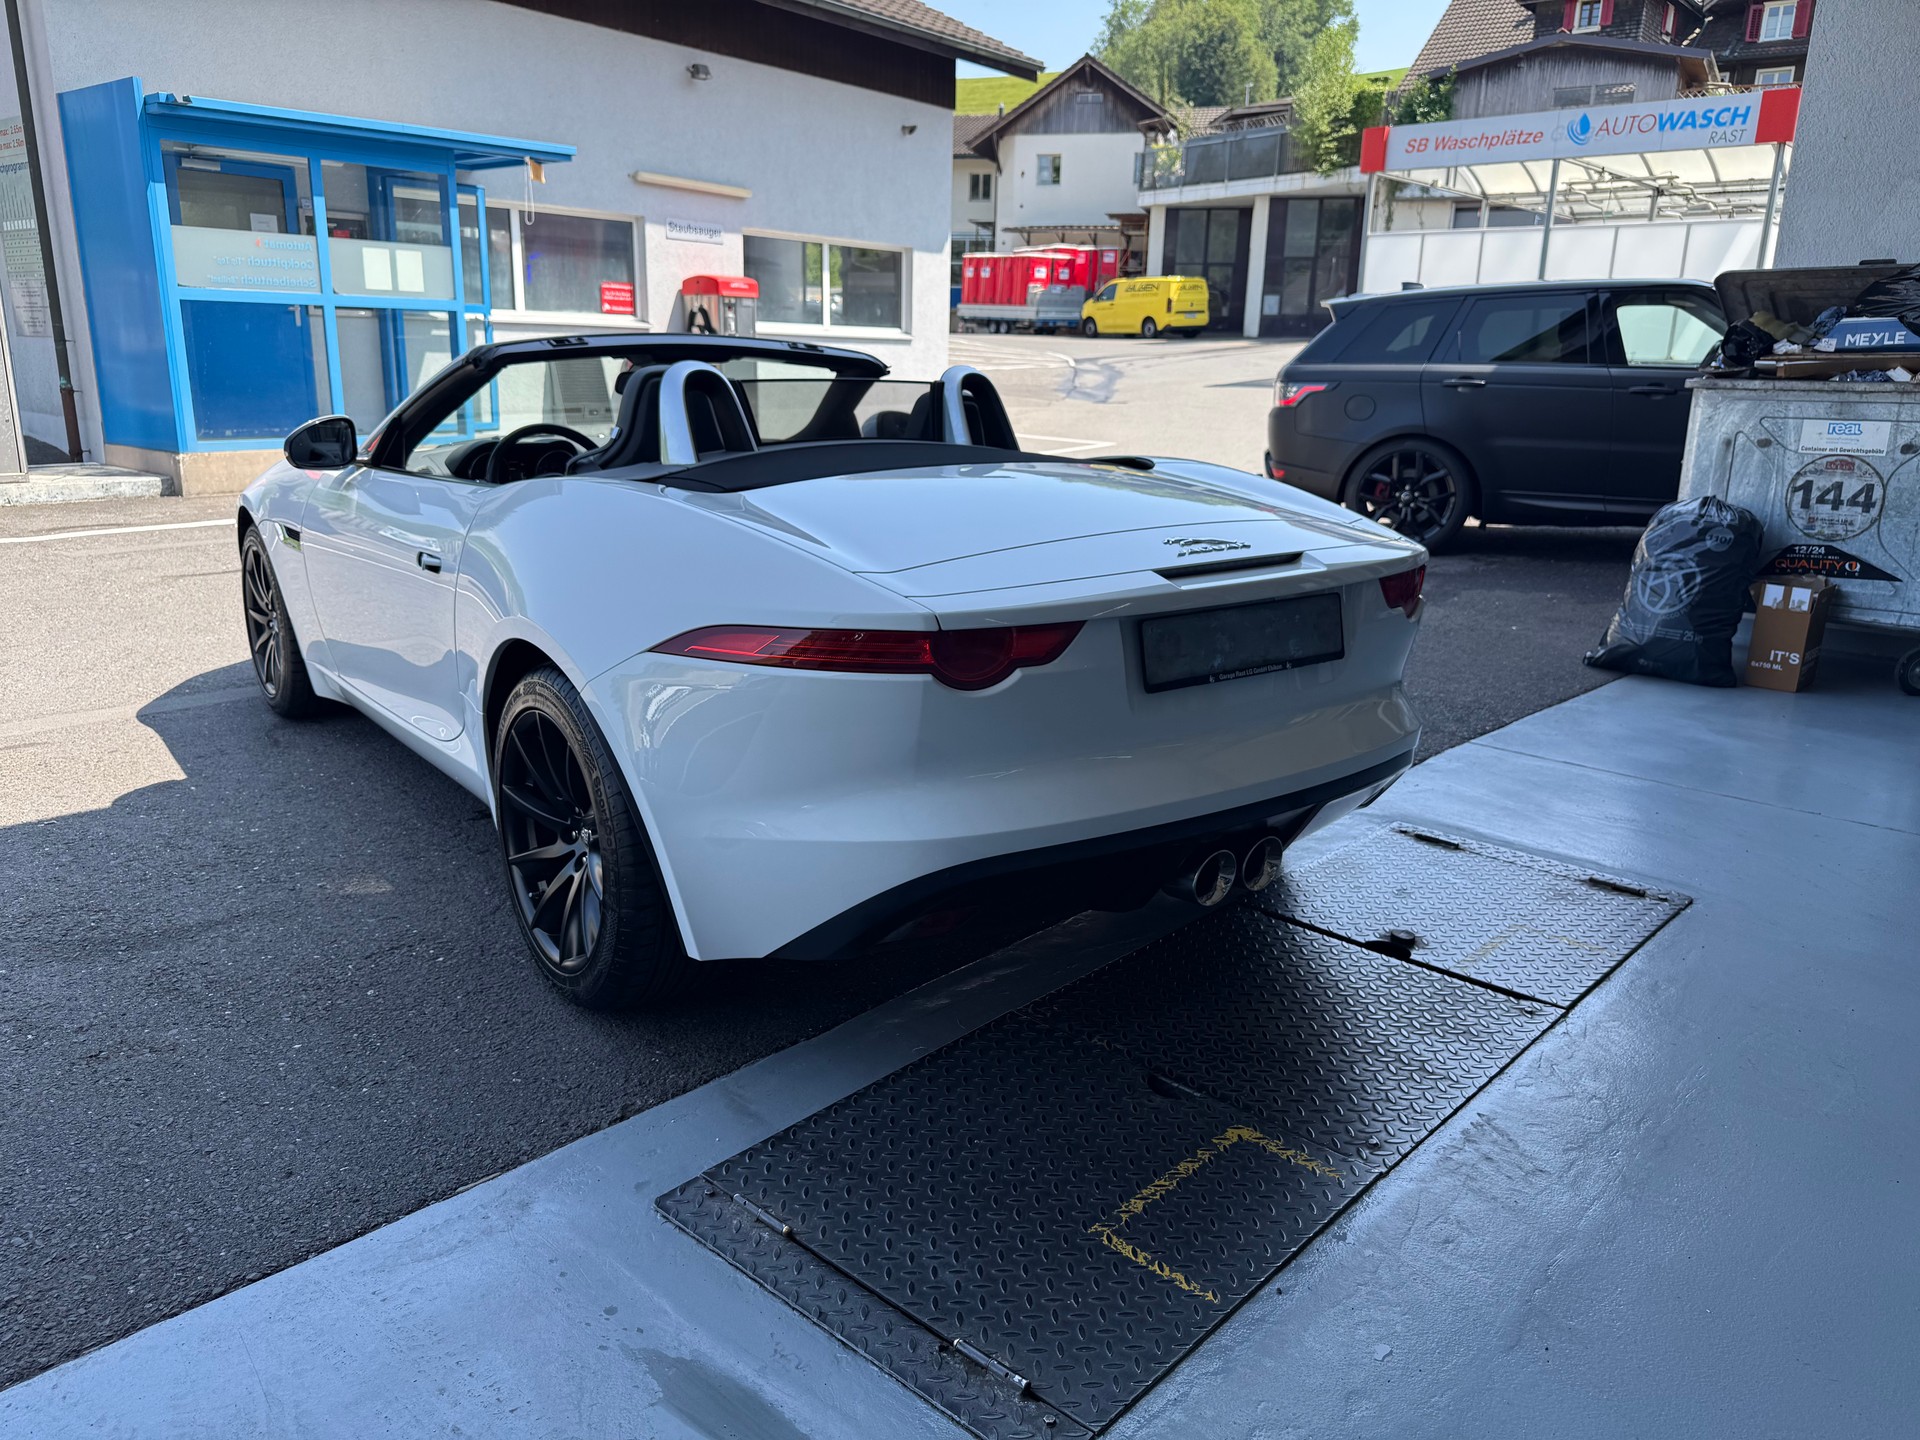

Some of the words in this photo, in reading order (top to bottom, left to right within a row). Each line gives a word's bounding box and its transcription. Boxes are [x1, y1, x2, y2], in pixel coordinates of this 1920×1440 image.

[1404, 137, 1430, 154] SB
[1434, 130, 1544, 151] Waschplätze
[1708, 129, 1748, 144] RAST
[668, 221, 722, 239] Staubsauger
[1845, 331, 1907, 347] MEYLE
[1827, 422, 1863, 435] real
[1800, 445, 1828, 453] Container
[1791, 480, 1877, 513] 144
[1794, 546, 1826, 555] 12/24
[1775, 559, 1844, 571] QUALITY
[1769, 649, 1800, 665] IT'S
[1772, 663, 1782, 671] ML
